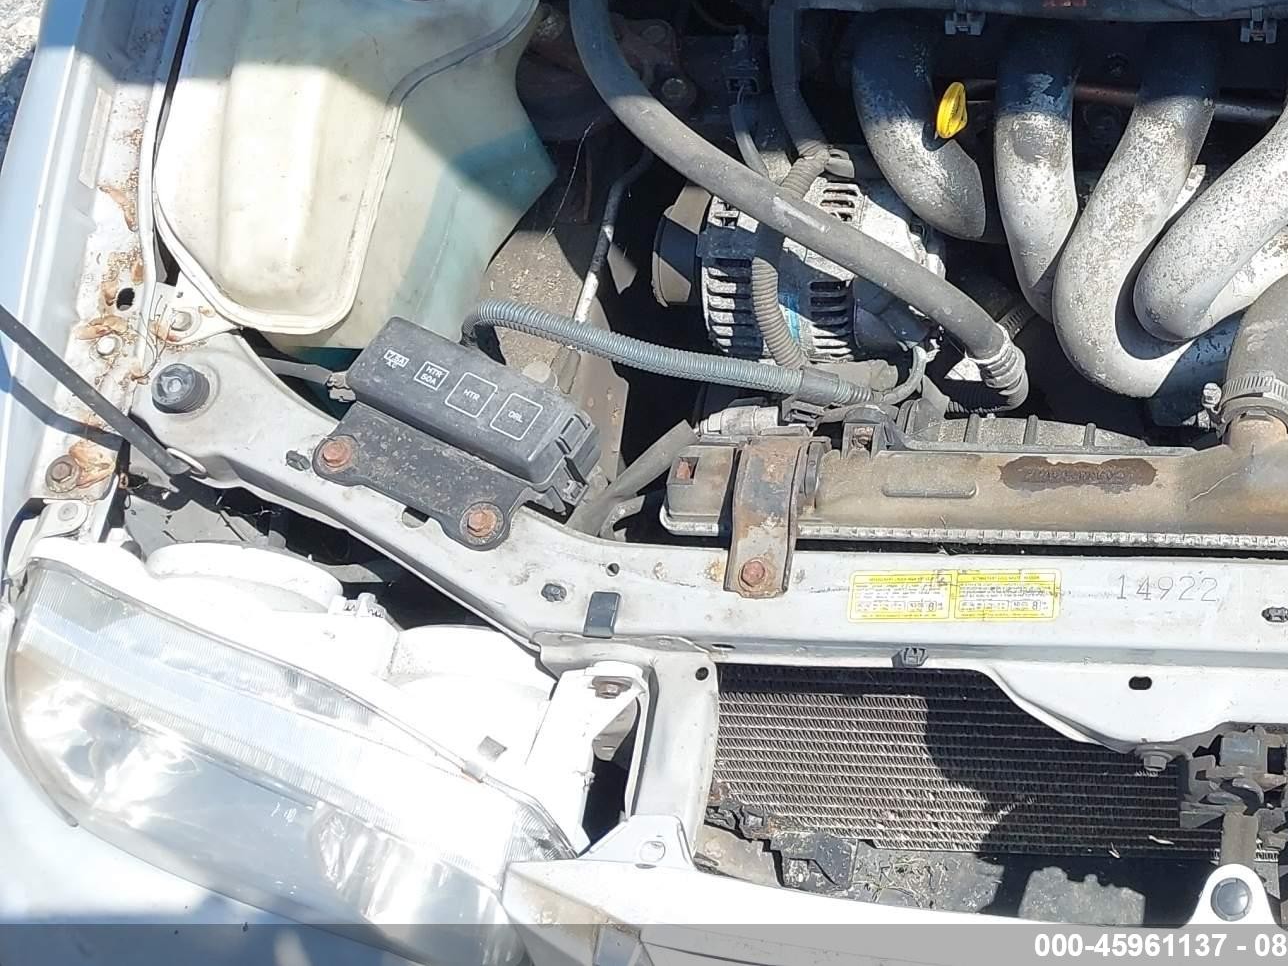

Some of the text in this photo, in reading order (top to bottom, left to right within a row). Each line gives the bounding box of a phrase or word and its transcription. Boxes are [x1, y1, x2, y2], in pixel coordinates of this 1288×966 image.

[425, 363, 443, 378] HTR
[463, 388, 480, 402] HTR
[1115, 572, 1220, 603] 14922
